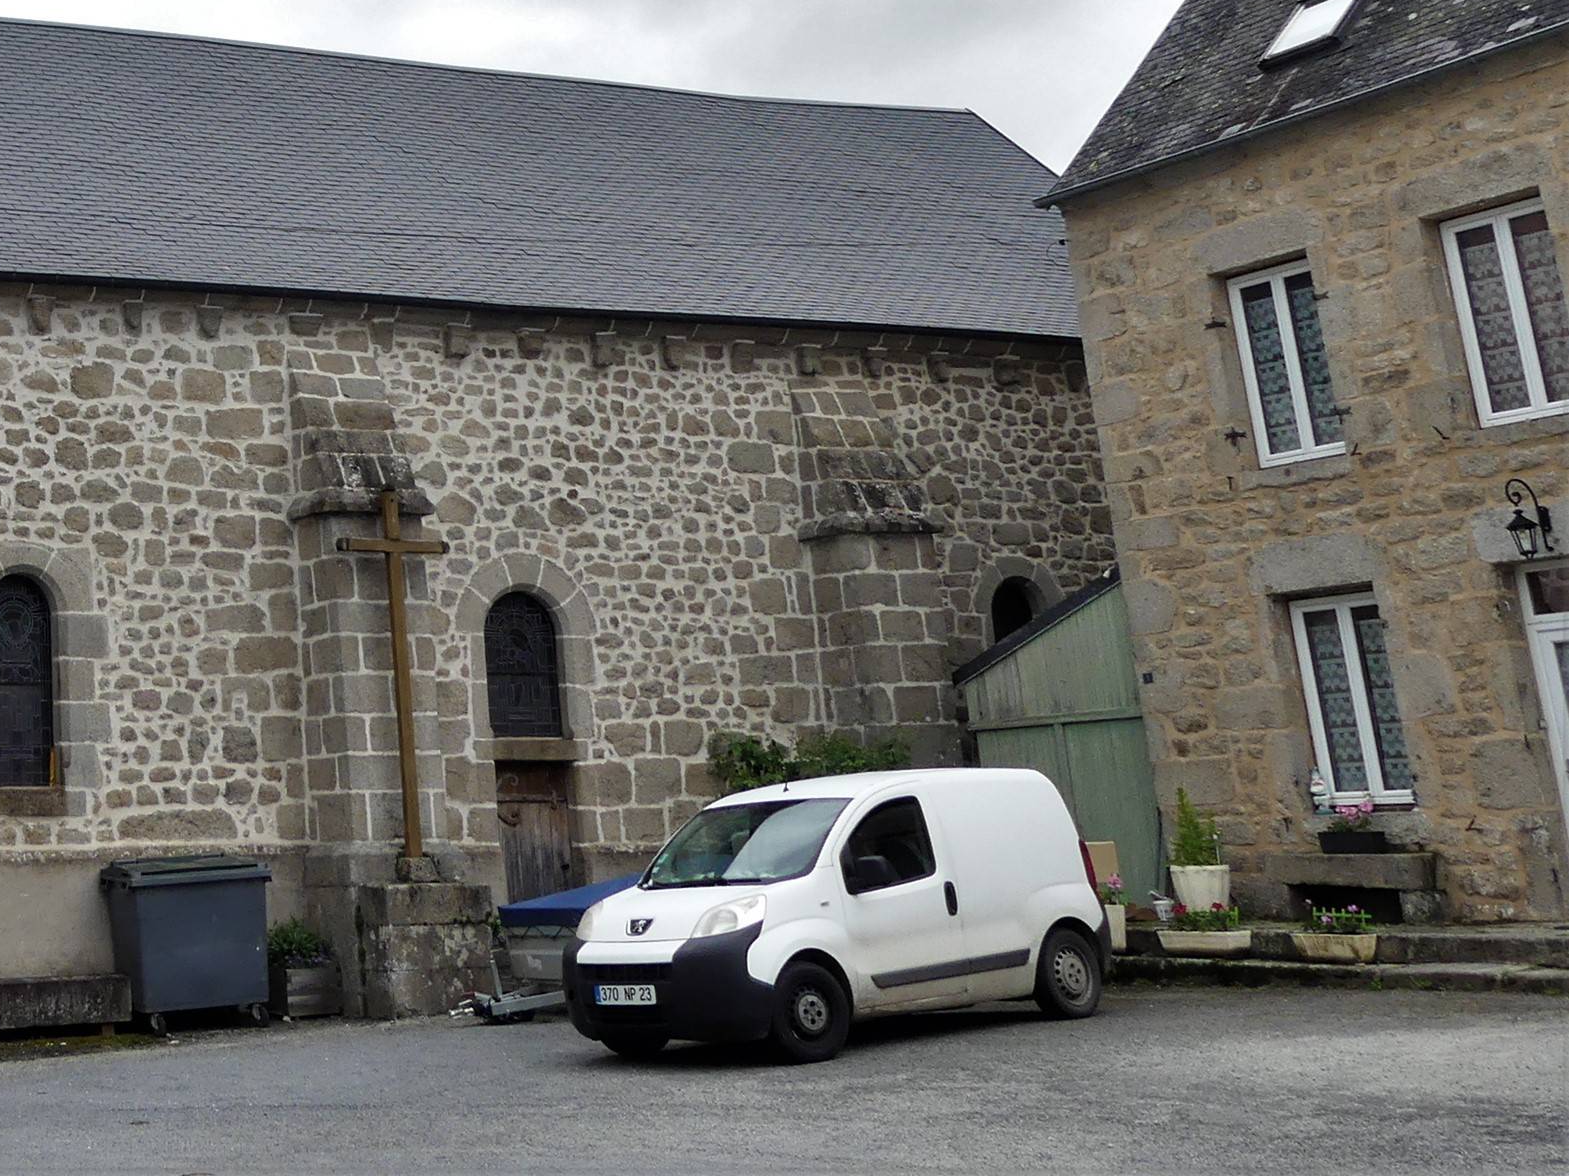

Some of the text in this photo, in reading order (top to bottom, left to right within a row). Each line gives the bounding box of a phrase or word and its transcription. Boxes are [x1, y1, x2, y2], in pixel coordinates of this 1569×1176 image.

[601, 987, 652, 1001] 370 NP 23
